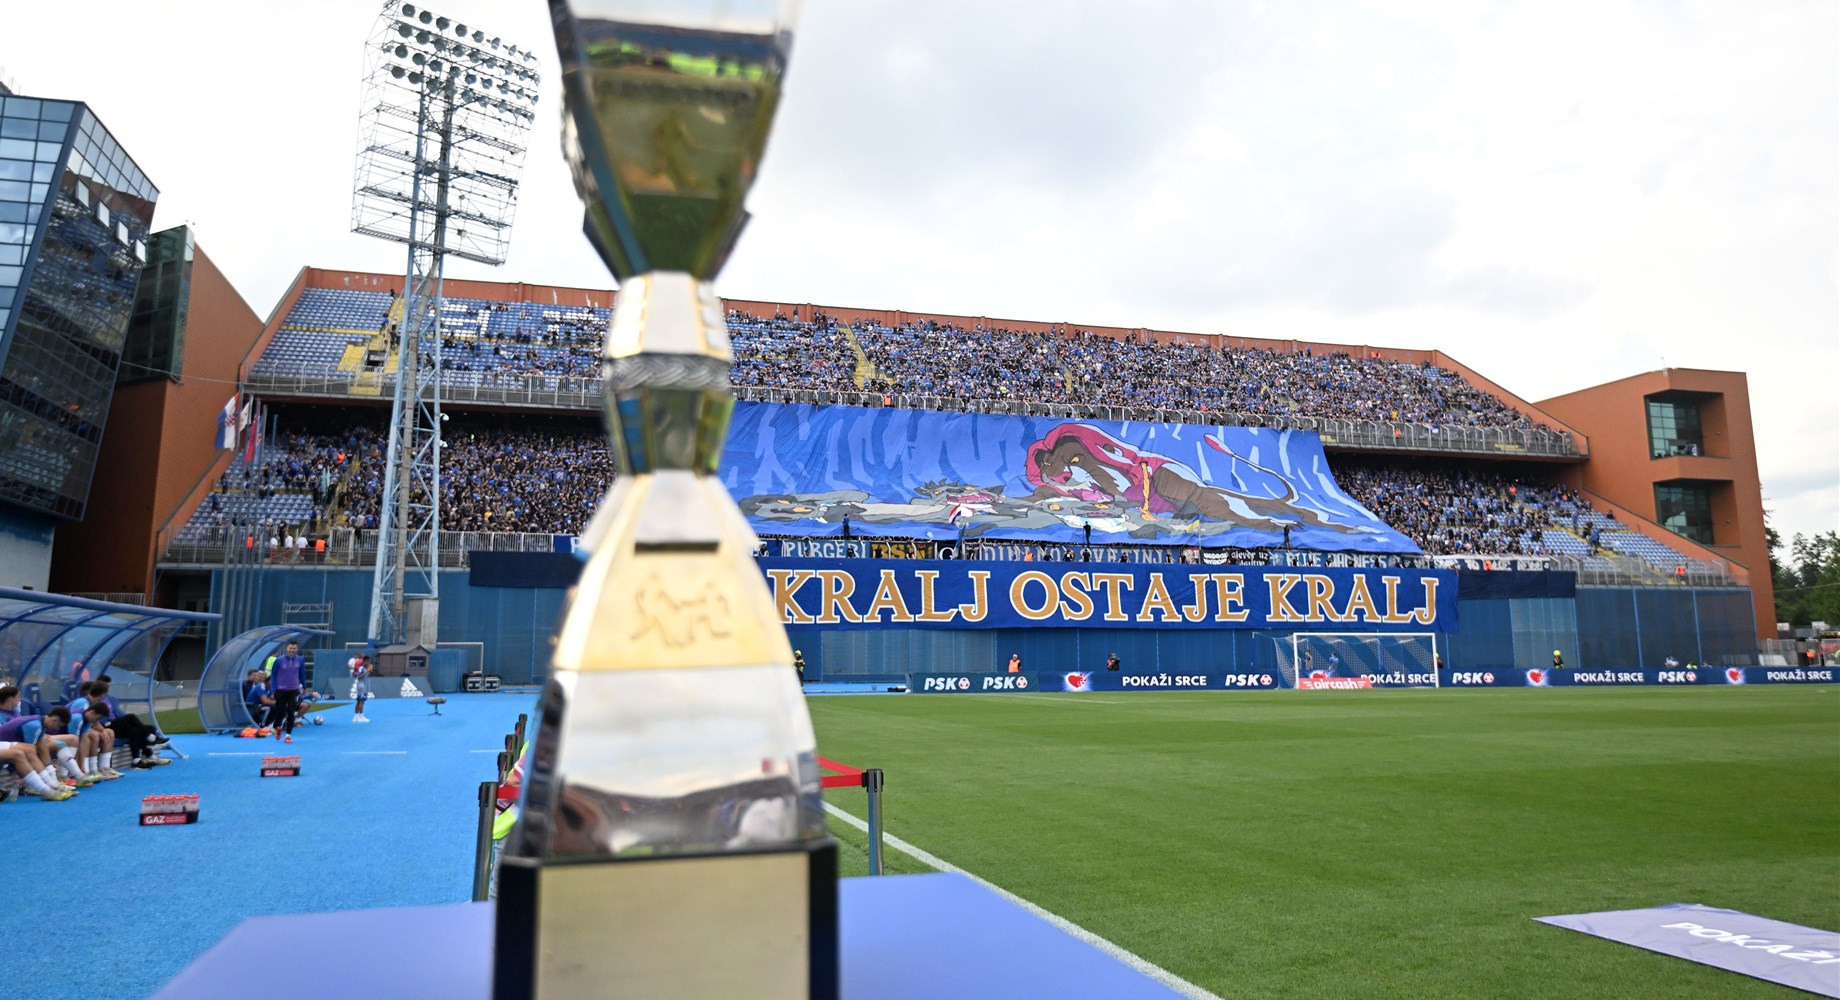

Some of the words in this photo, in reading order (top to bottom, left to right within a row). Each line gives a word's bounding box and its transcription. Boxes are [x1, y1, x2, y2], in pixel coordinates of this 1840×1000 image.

[767, 569, 990, 624] KRALJ
[1009, 570, 1250, 622] OSTAJE
[1263, 573, 1439, 624] KRALJ
[1122, 673, 1171, 686] POKAŽI
[1175, 675, 1207, 686] SRCE
[1225, 674, 1260, 686] PSK
[1407, 674, 1435, 684] SRCE
[1452, 672, 1484, 684] PSK
[1574, 670, 1615, 682] POKAŽI
[1617, 672, 1644, 682] SRCE
[1658, 671, 1687, 682] PSK
[1767, 668, 1805, 680] POKAŽI
[1807, 671, 1832, 680] SRCE
[924, 677, 958, 690] PSK
[982, 676, 1016, 689] PSK
[1312, 678, 1358, 689] aircash
[145, 815, 166, 824] GAZ
[1660, 922, 1840, 964] POKAŽI
